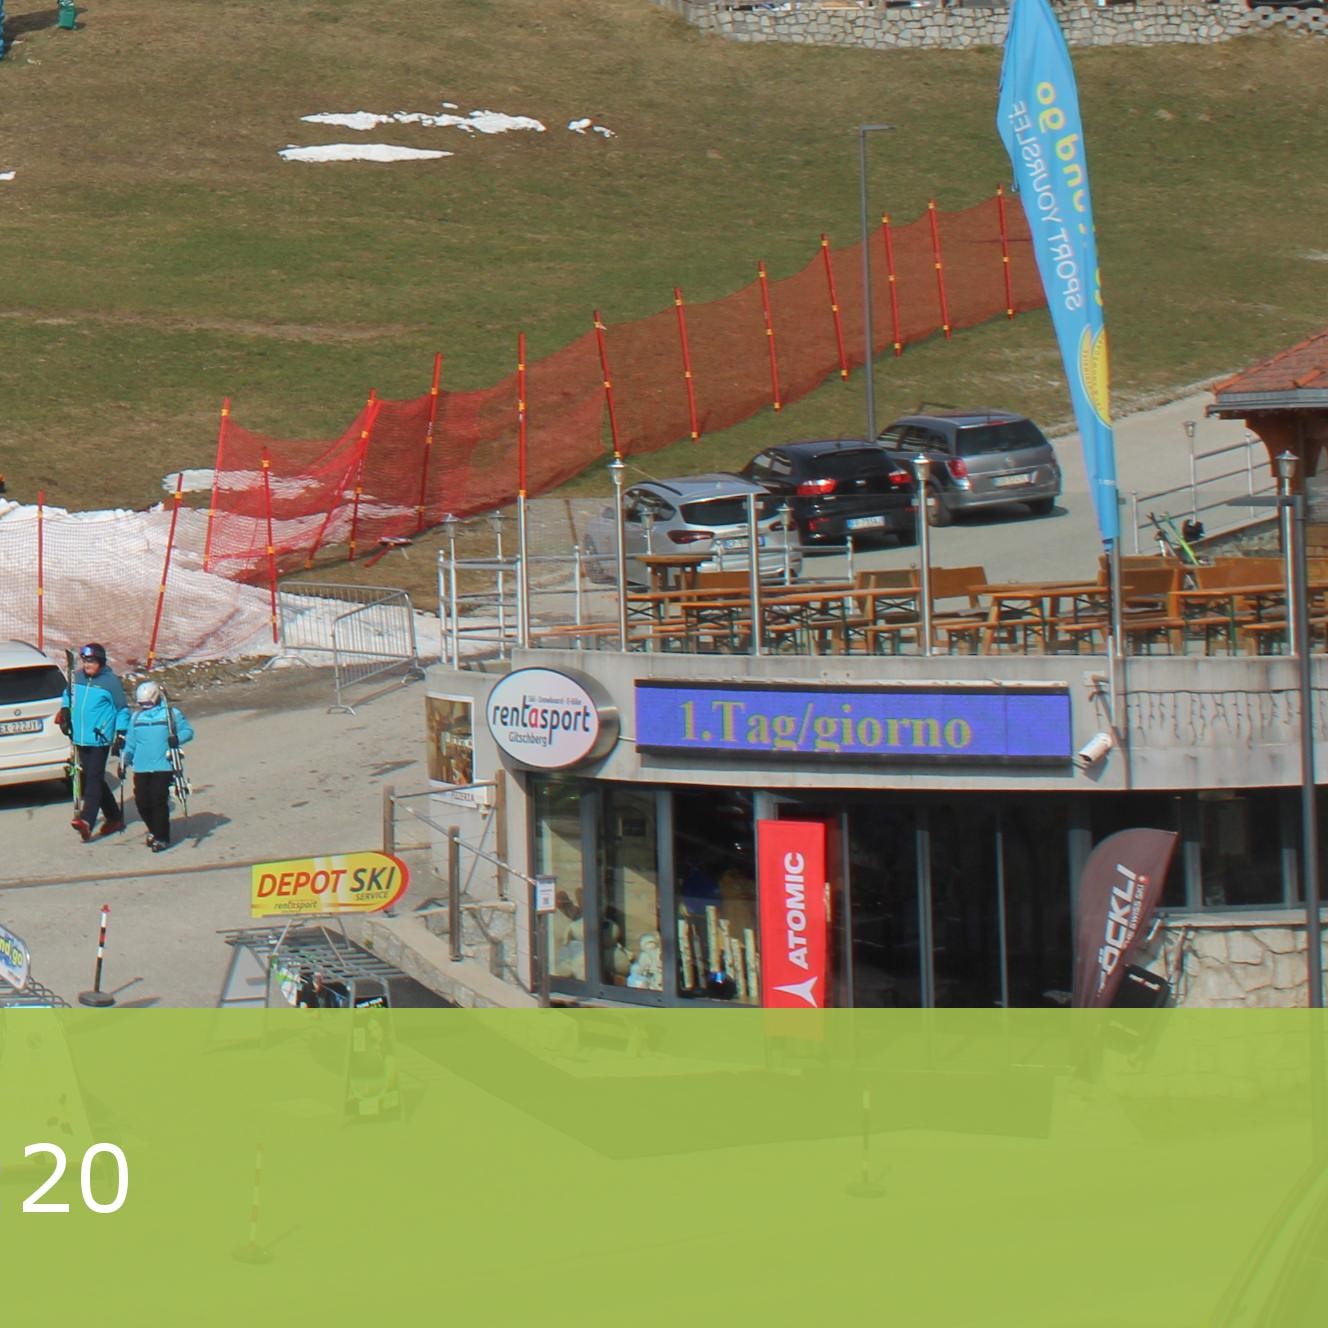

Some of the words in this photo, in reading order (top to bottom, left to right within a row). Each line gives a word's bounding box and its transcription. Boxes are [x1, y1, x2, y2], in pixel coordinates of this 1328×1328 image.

[492, 694, 592, 745] rentasport
[508, 731, 548, 748] Gitschberg
[679, 699, 973, 753] 1.Tag/giorno
[256, 868, 348, 898] DEPOT
[349, 865, 397, 893] SKI
[355, 891, 390, 901] SERVICE
[783, 851, 809, 970] ATOMIC
[1097, 864, 1138, 997] ÖCKLI
[11, 947, 24, 968] go
